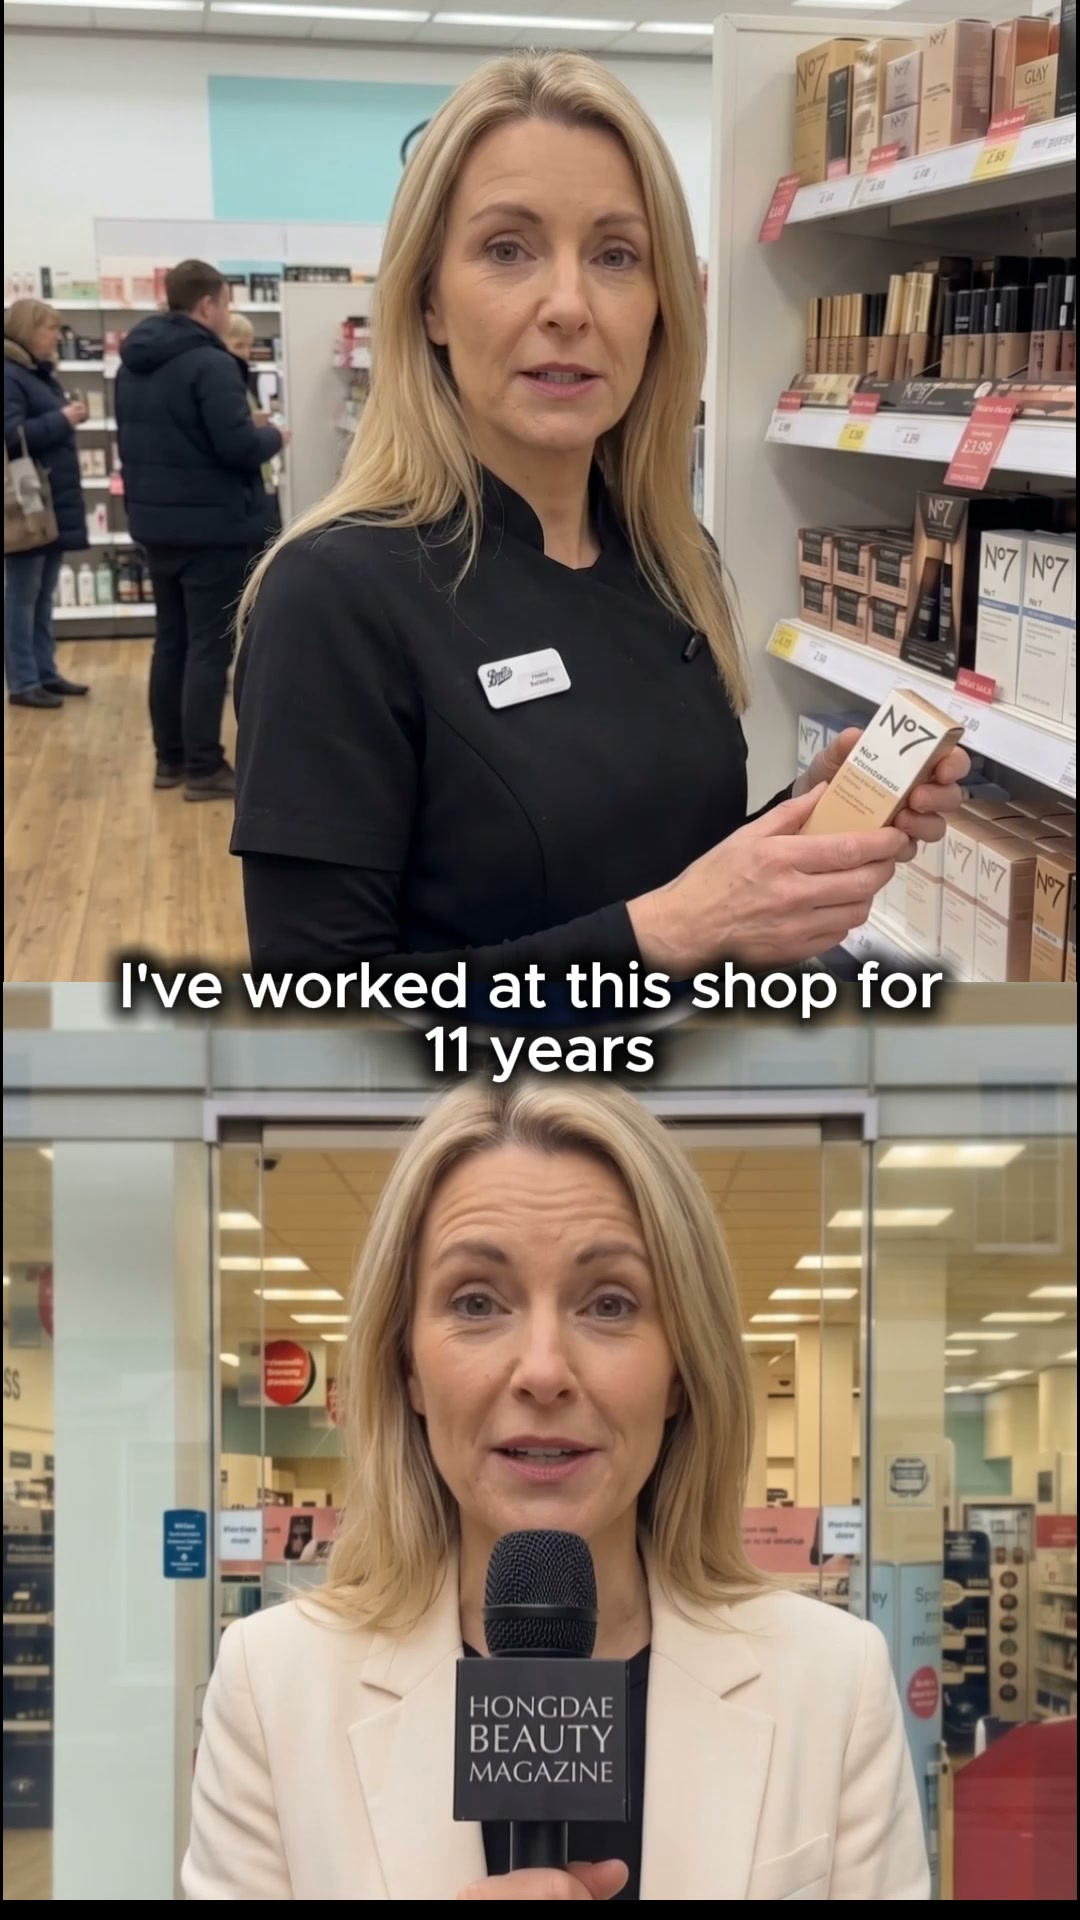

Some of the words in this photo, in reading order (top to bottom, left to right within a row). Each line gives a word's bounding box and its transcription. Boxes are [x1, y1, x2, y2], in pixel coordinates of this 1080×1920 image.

[469, 1695, 614, 1719] HONGDAE
[469, 1724, 614, 1754] BEAUTY
[469, 1760, 614, 1784] MAGAZINE
